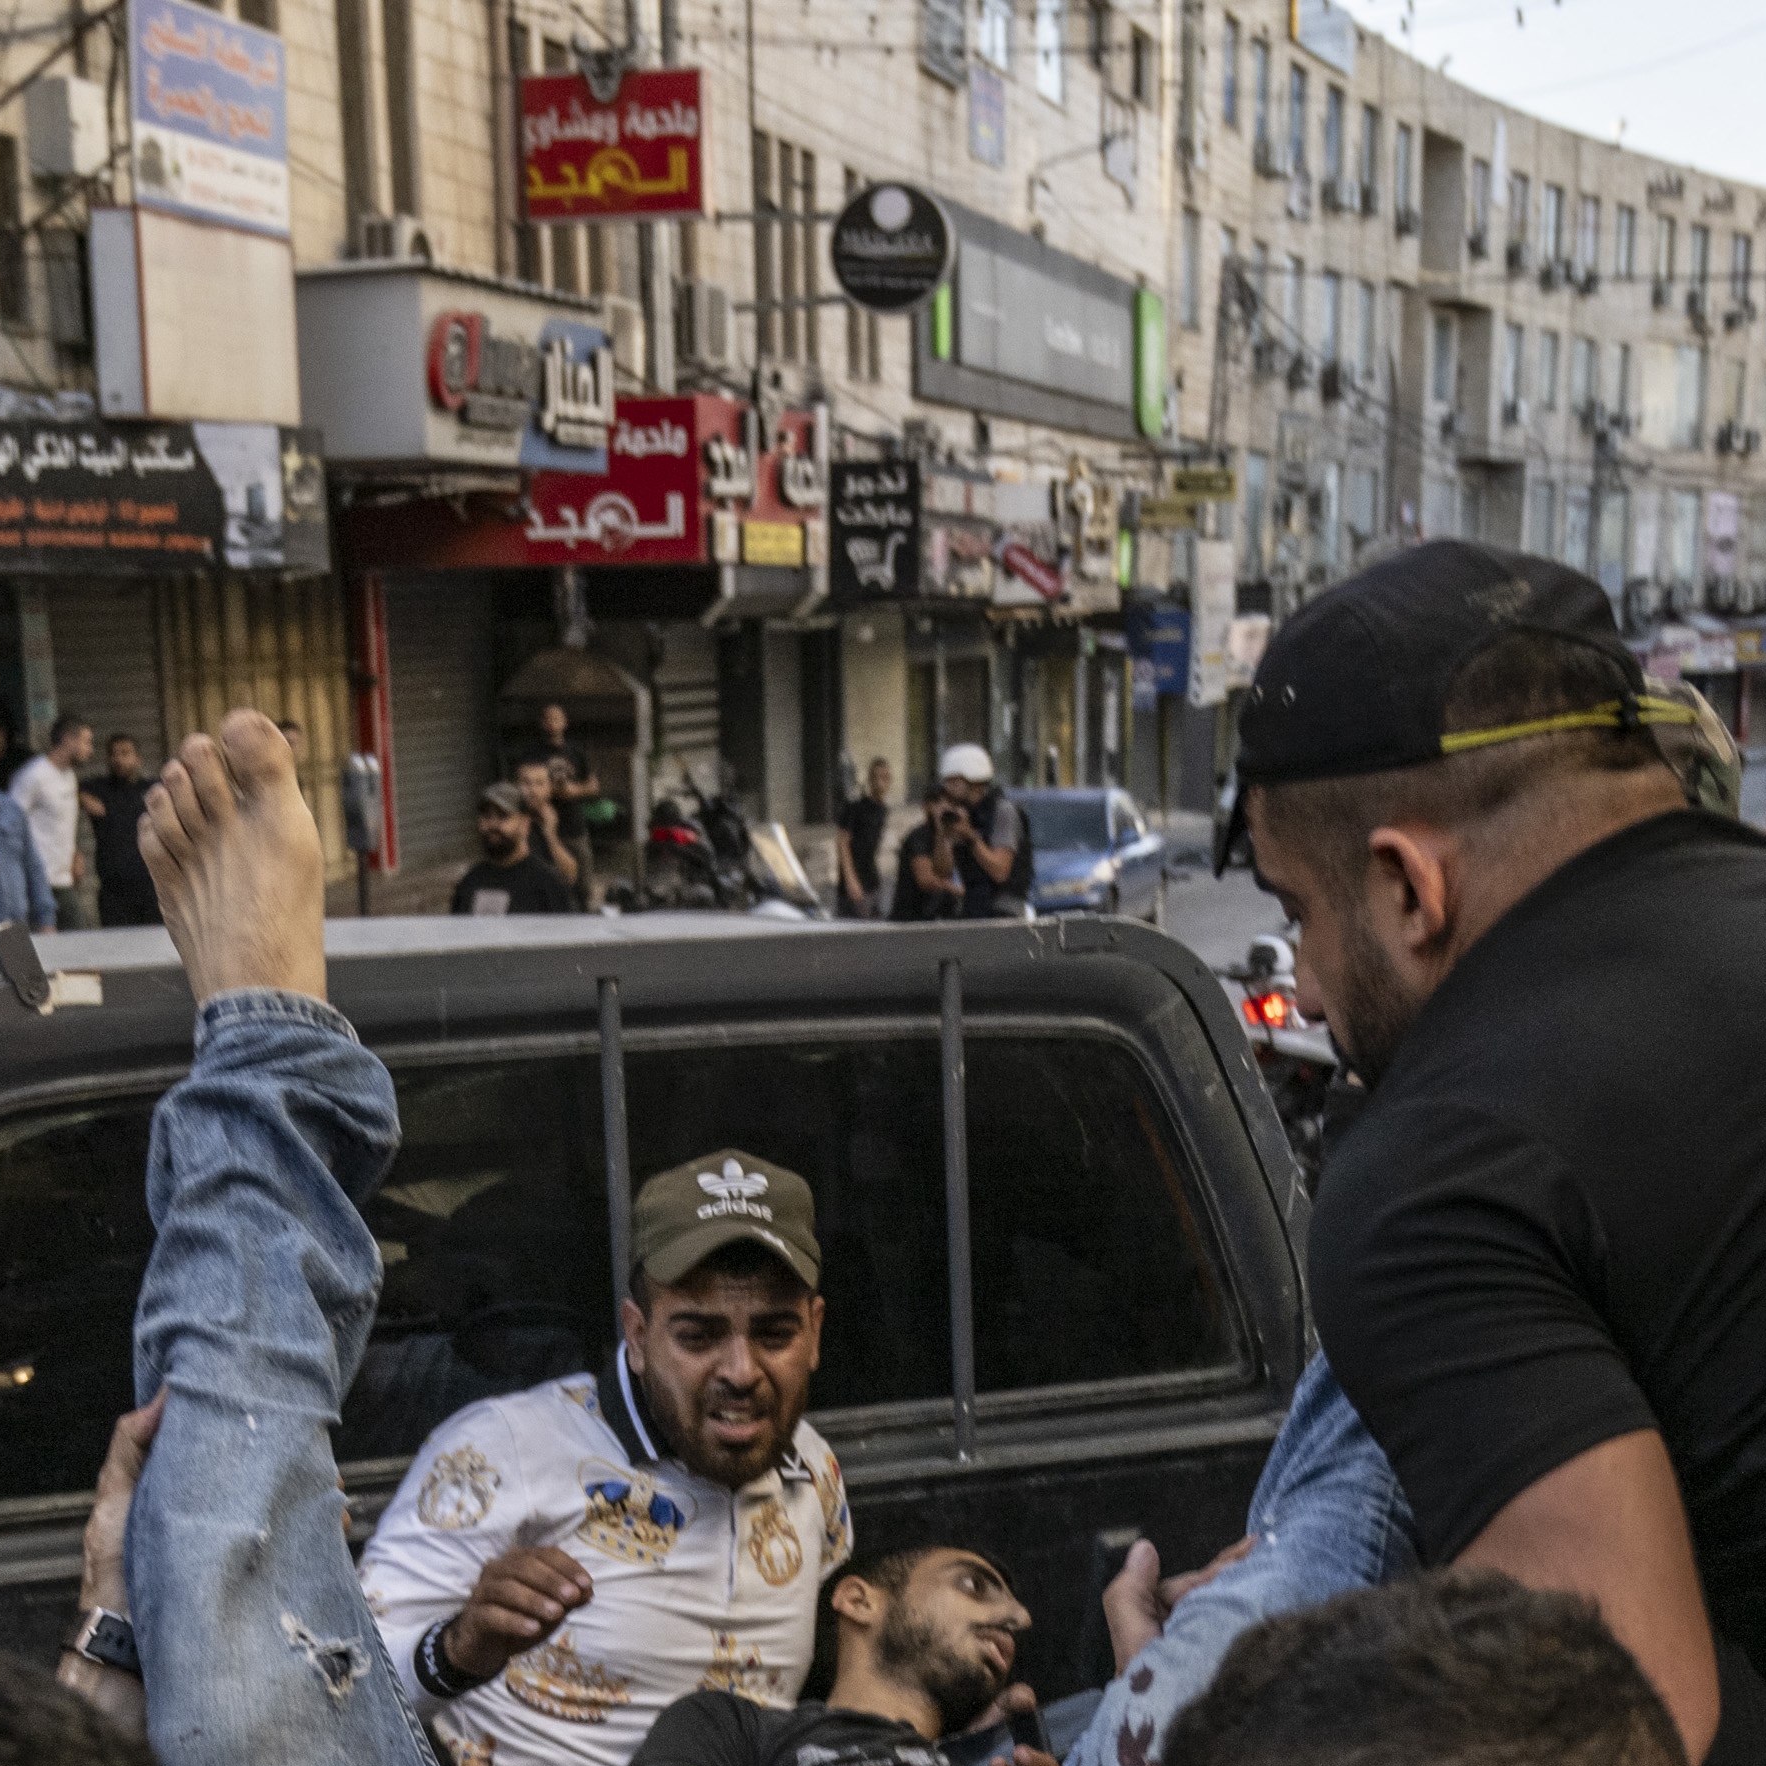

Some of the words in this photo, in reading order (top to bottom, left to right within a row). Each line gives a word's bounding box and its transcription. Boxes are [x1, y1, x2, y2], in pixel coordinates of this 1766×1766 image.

[623, 99, 700, 142] ملحمة
[613, 418, 690, 459] ملحمة
[695, 1198, 774, 1224] adidas
